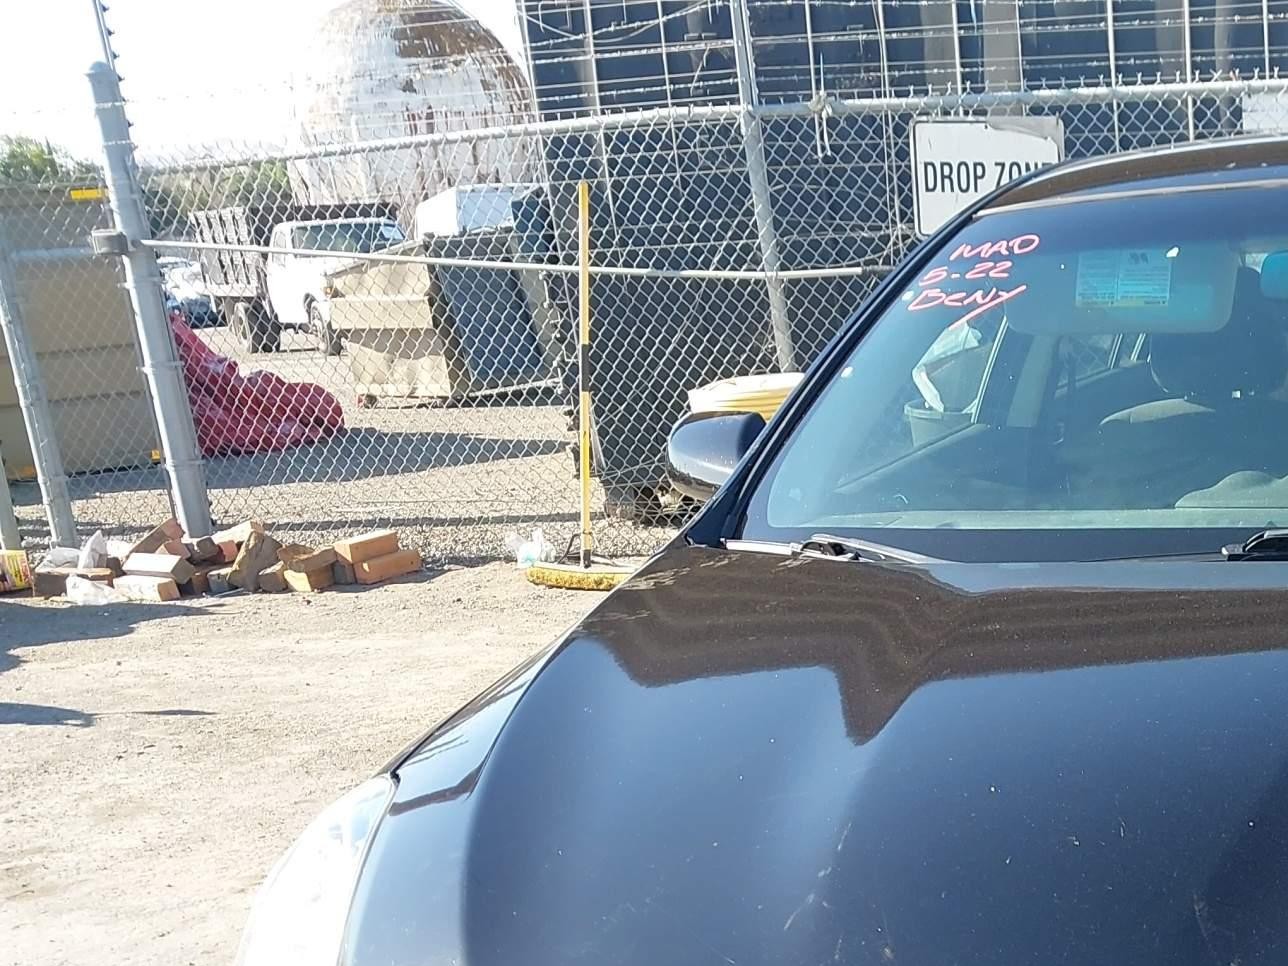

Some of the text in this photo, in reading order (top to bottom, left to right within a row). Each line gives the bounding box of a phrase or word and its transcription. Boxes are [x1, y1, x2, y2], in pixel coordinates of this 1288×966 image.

[923, 160, 1053, 194] DROP ZO
[918, 260, 1013, 287] 5-22
